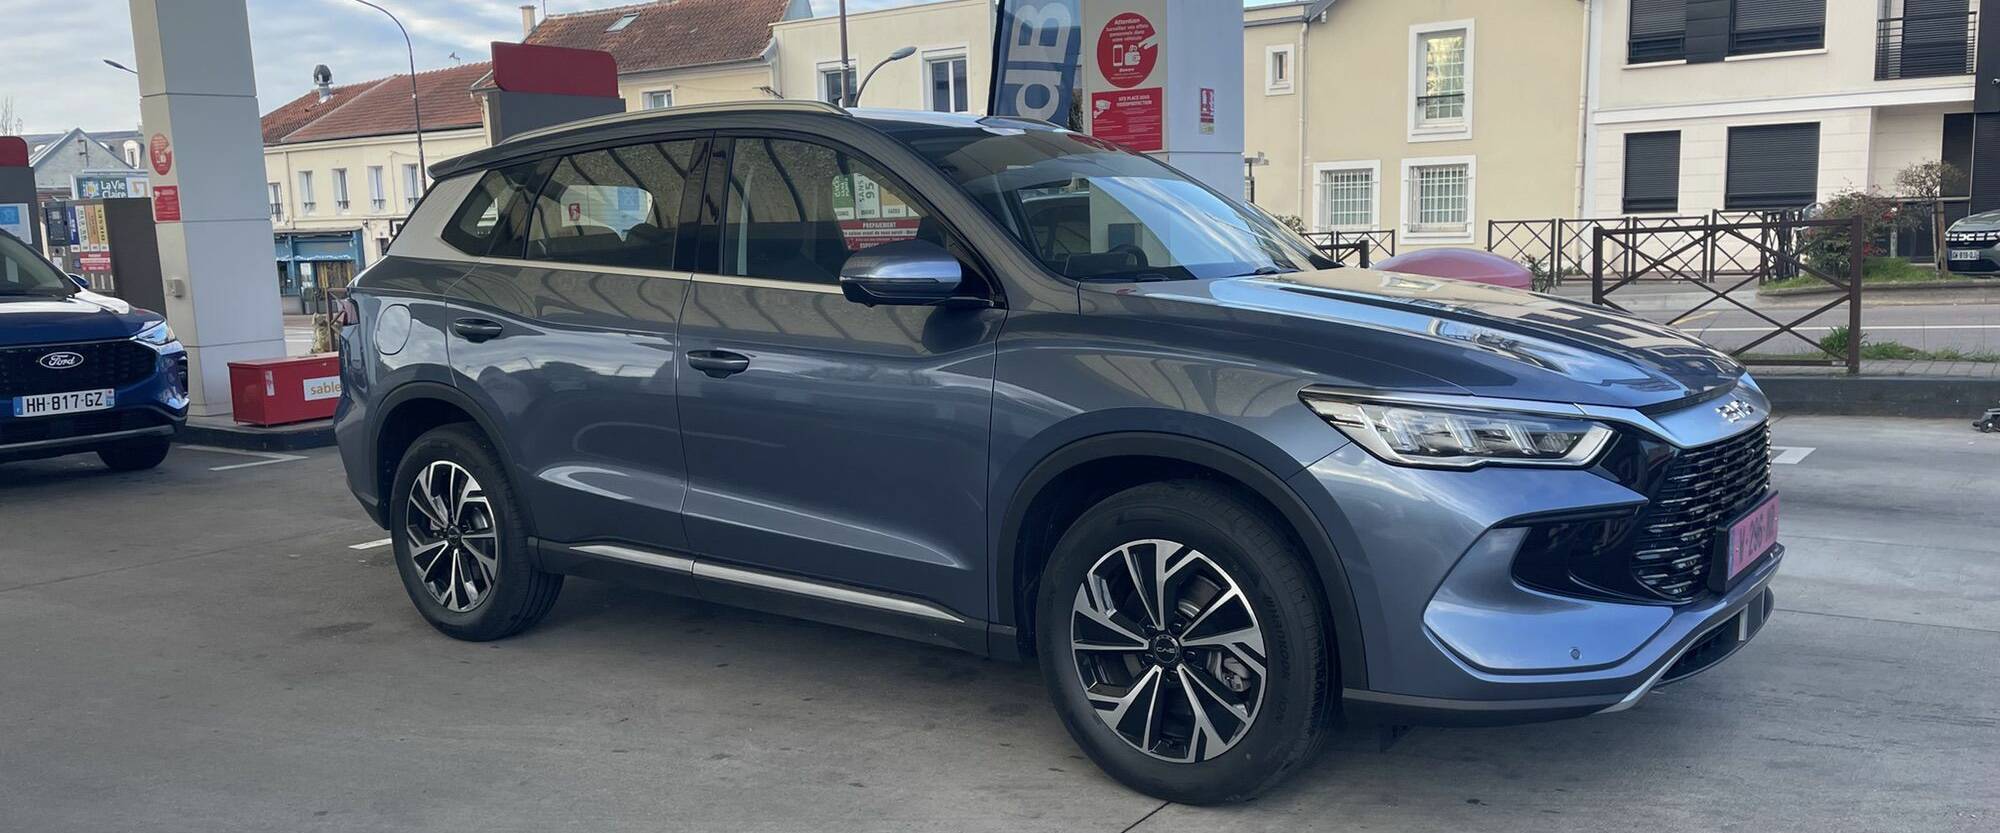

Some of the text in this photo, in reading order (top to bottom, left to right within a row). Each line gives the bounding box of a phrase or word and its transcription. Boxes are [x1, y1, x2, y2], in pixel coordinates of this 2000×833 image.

[865, 182, 875, 199] 95
[48, 354, 76, 366] Ford
[310, 382, 341, 395] sable
[26, 392, 103, 413] HH-817-GZ
